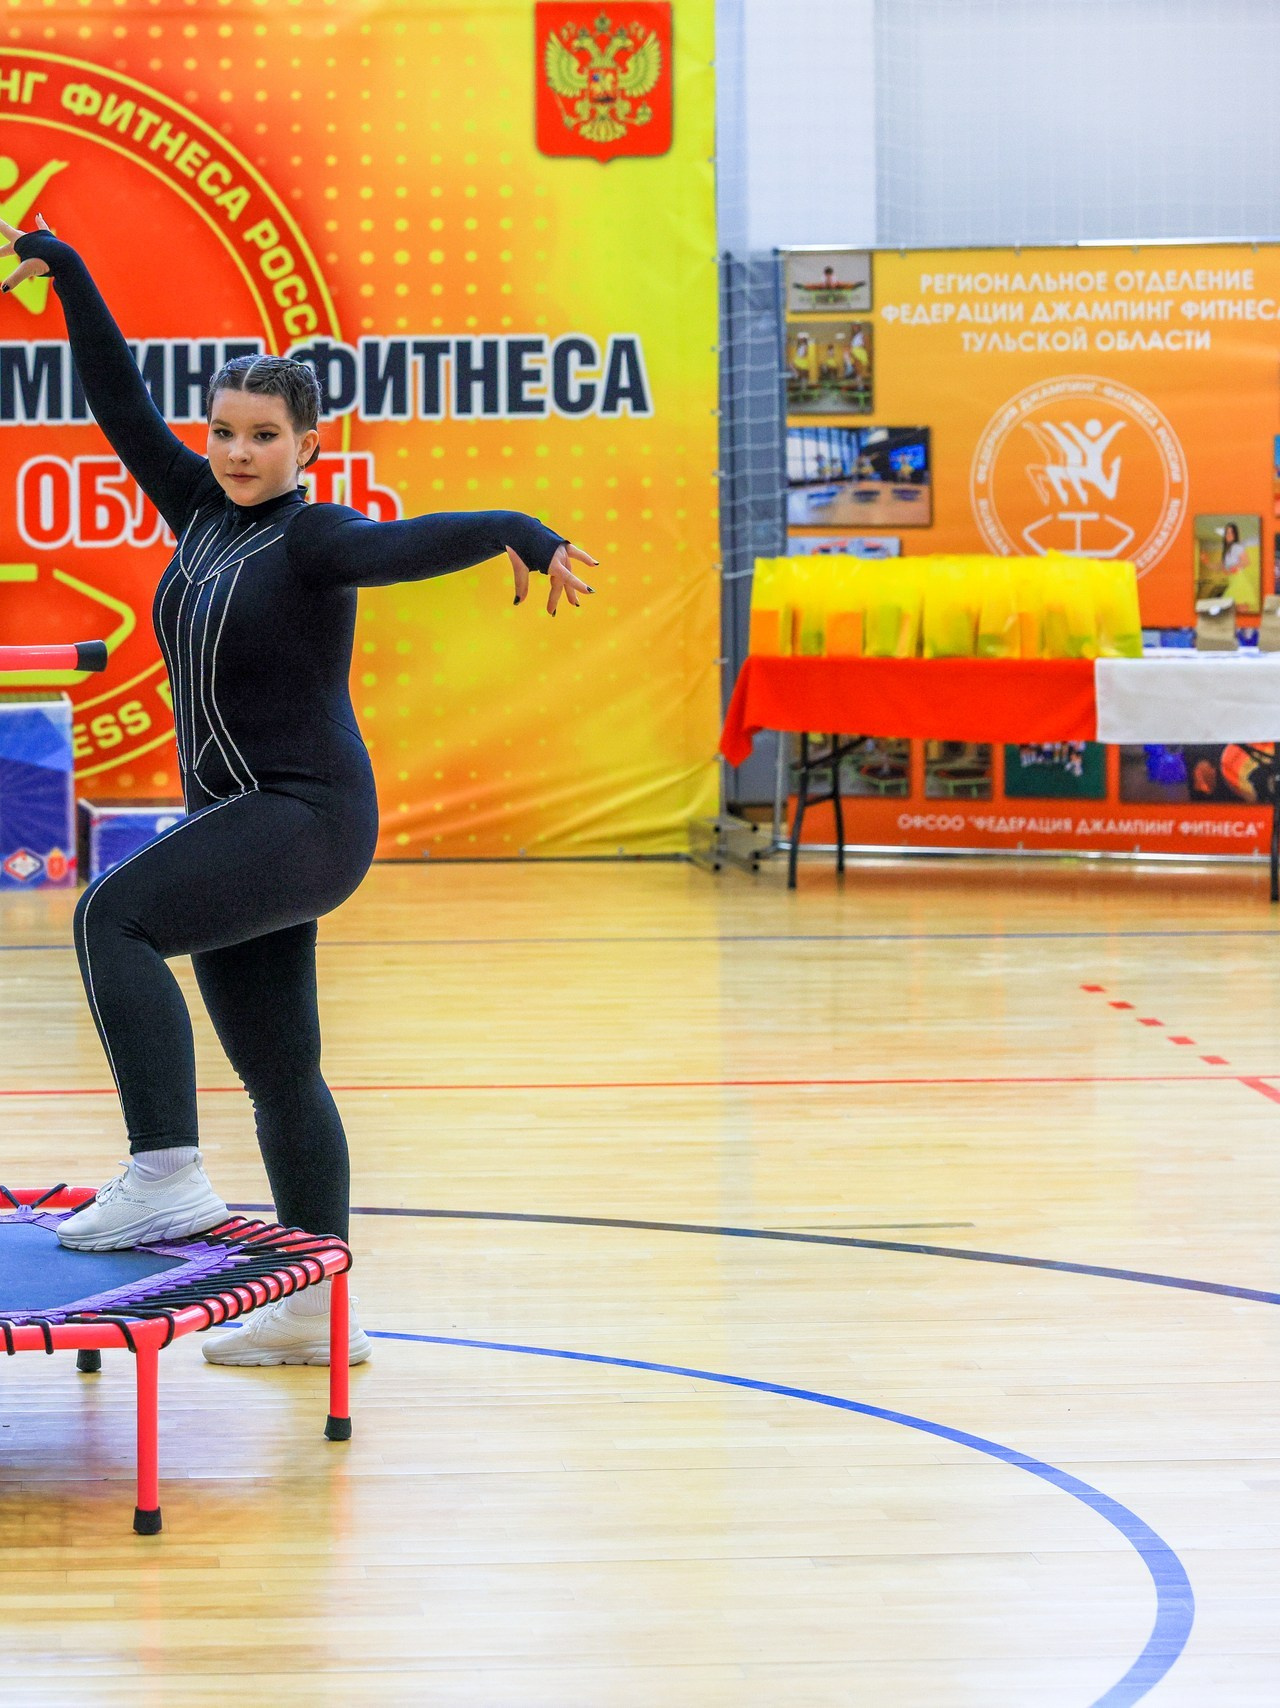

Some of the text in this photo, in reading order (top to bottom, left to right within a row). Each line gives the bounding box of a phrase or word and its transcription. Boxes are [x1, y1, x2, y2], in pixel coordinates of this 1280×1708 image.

[61, 83, 251, 222] ФИТНЕСА
[243, 218, 322, 346] РОСС
[920, 269, 1254, 294] РЕГИОНАЛЬНОЕ ОТДЕЛЕНИЕ
[881, 298, 1280, 326] ФЕДЕРАЦИИ ДЖАМПИНГ ФИТНЕС
[961, 328, 1212, 352] ТУЛЬСКОЙ ОБЛАСТИ
[284, 332, 652, 420] ФИТНЕСА
[1076, 817, 1174, 837] ДЖАМПИНГ
